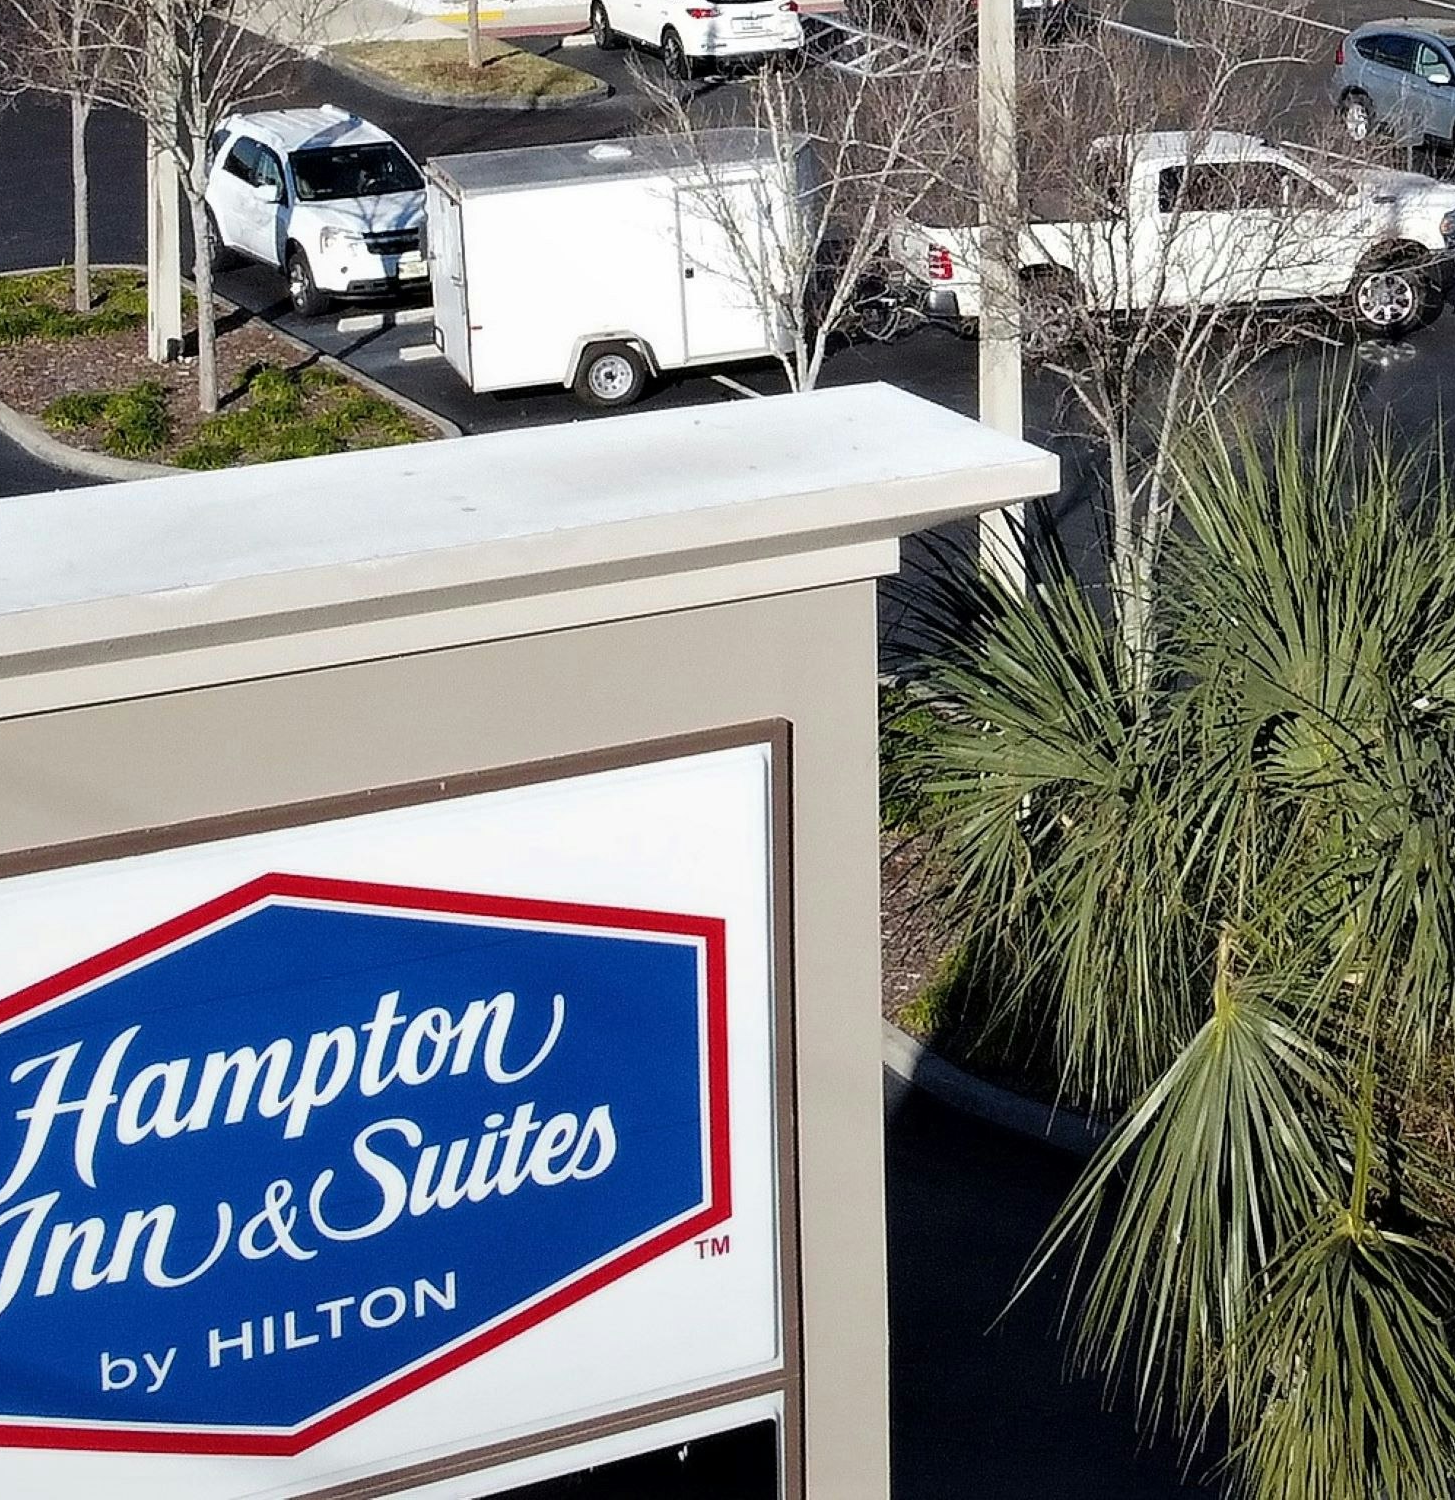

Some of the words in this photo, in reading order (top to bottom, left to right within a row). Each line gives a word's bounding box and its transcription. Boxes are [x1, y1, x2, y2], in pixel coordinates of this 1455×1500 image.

[238, 1177, 319, 1262] &
[309, 1102, 617, 1242] Suites
[693, 1234, 732, 1261] TM
[99, 1338, 178, 1394] by
[207, 1270, 459, 1369] HILTON
